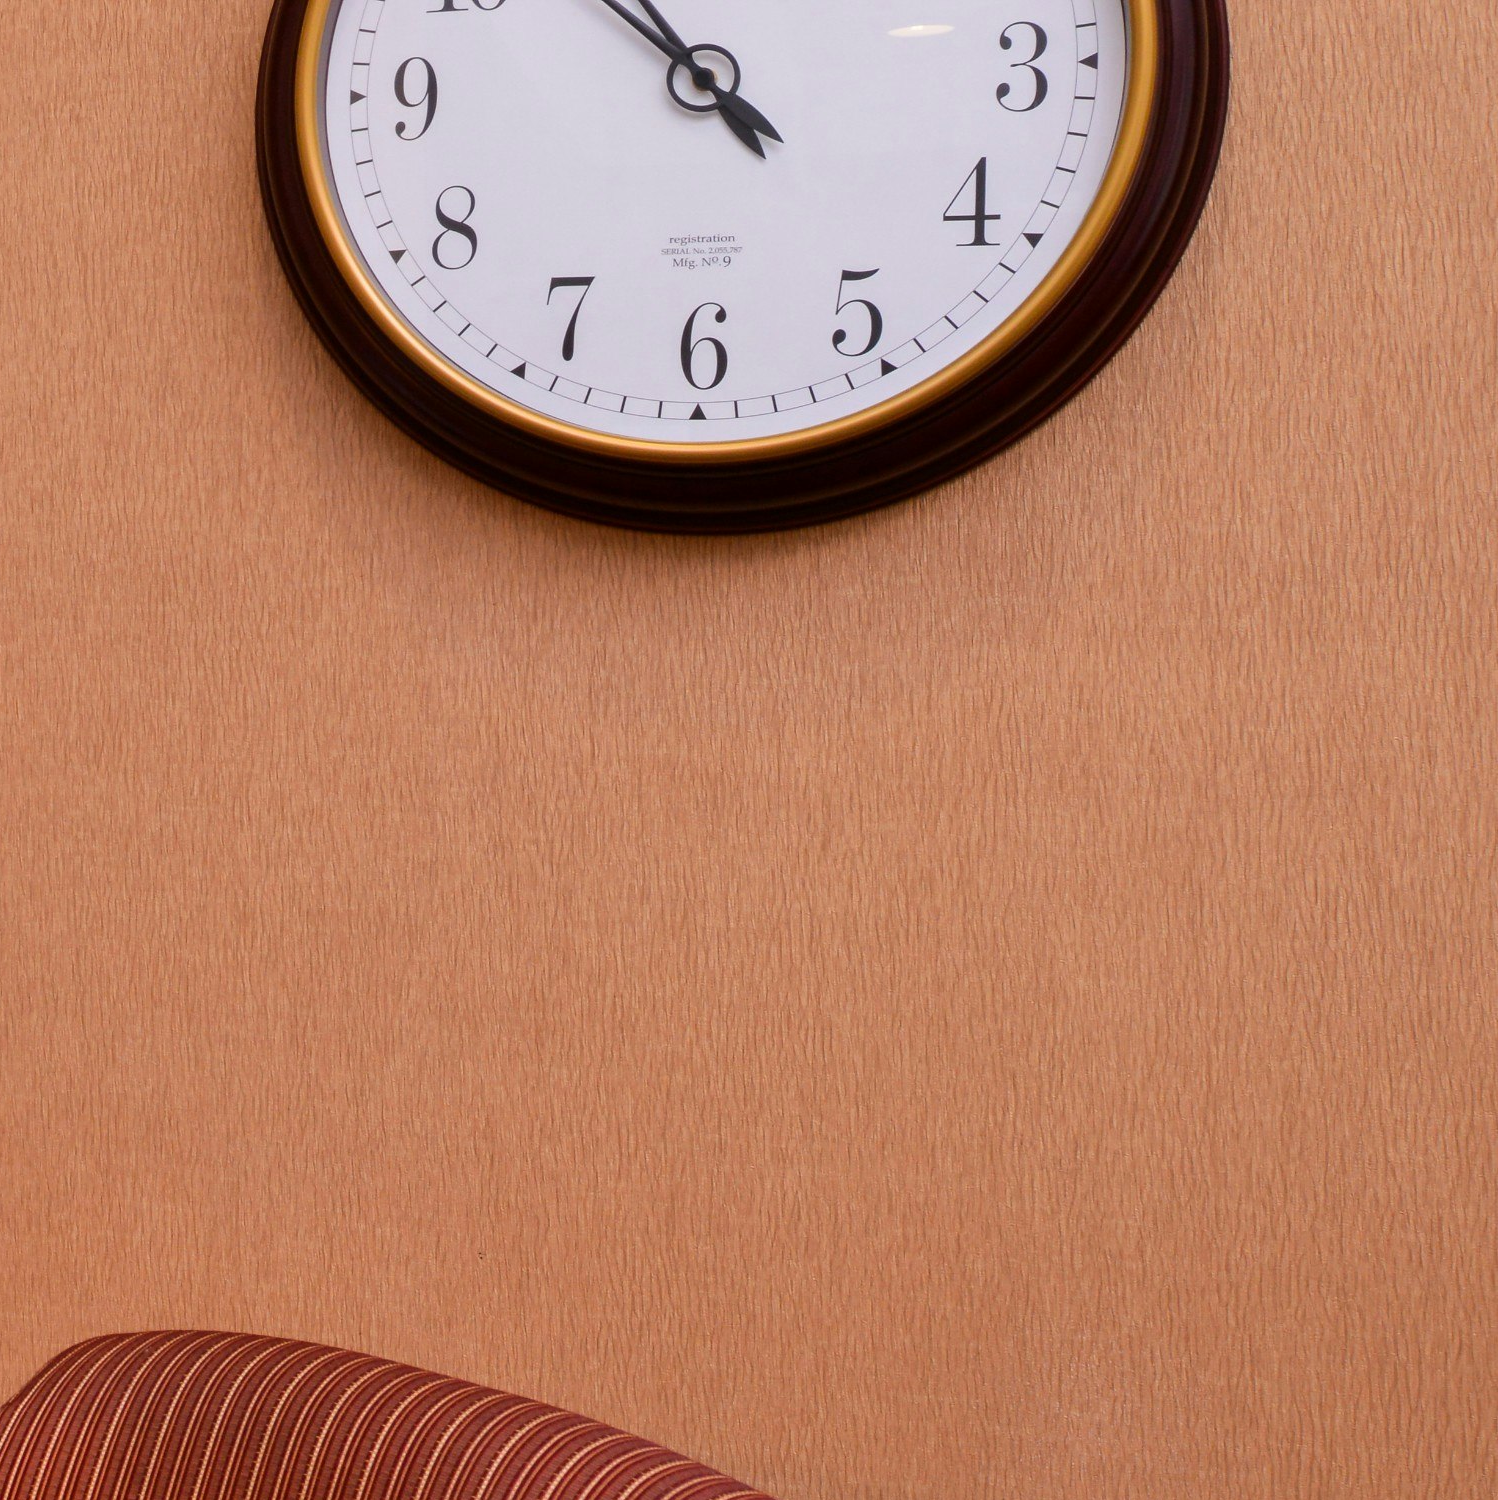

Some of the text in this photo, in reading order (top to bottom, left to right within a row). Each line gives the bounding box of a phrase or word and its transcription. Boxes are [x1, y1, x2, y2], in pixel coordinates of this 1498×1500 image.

[394, 56, 438, 141] 9
[996, 21, 1048, 113] 3
[431, 185, 478, 270] 8
[669, 234, 735, 246] registration
[942, 156, 1001, 247] 4
[672, 257, 698, 270] Mfg.
[546, 276, 596, 362] 7
[680, 302, 728, 391] 6
[831, 268, 883, 356] 5
